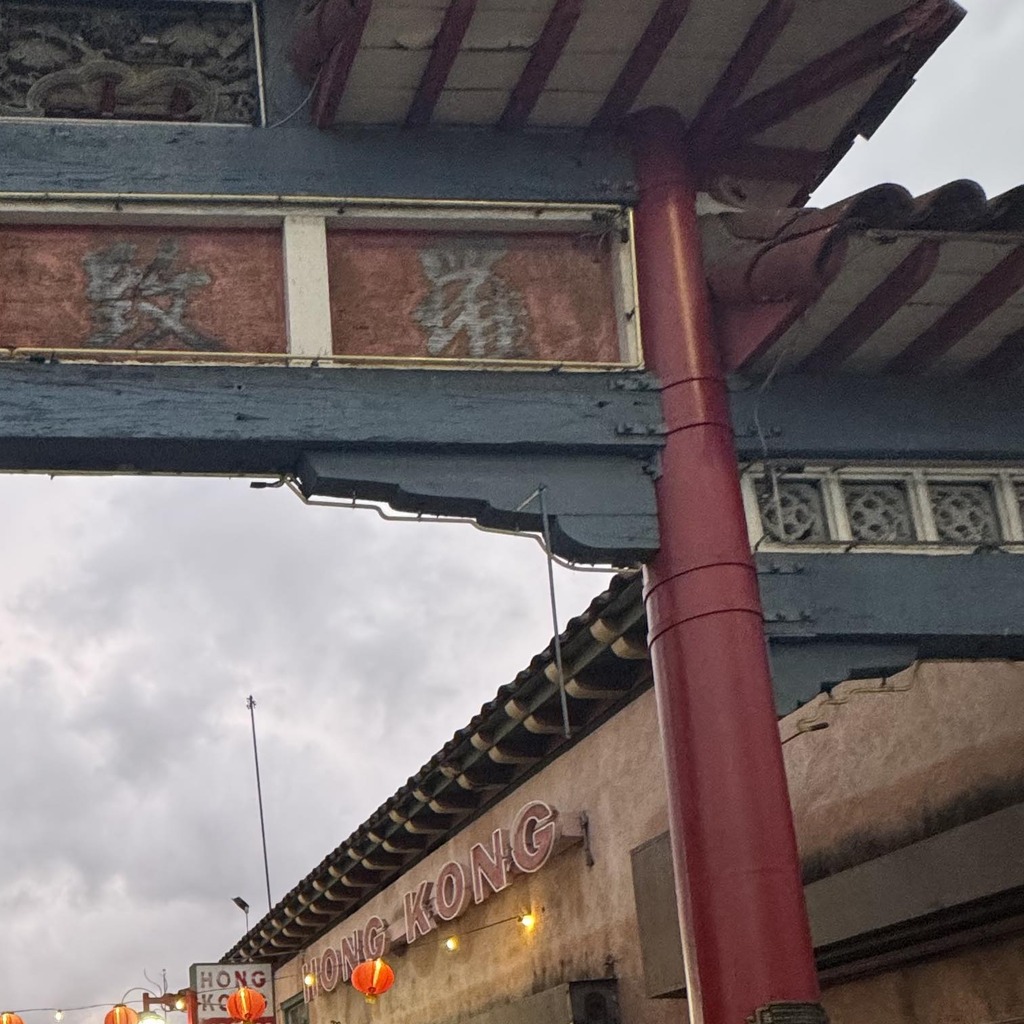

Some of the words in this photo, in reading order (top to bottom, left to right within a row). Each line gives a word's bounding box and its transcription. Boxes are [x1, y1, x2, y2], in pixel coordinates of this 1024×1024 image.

[302, 915, 389, 1003] HONG
[404, 800, 559, 945] KONG
[200, 970, 266, 988] HONG
